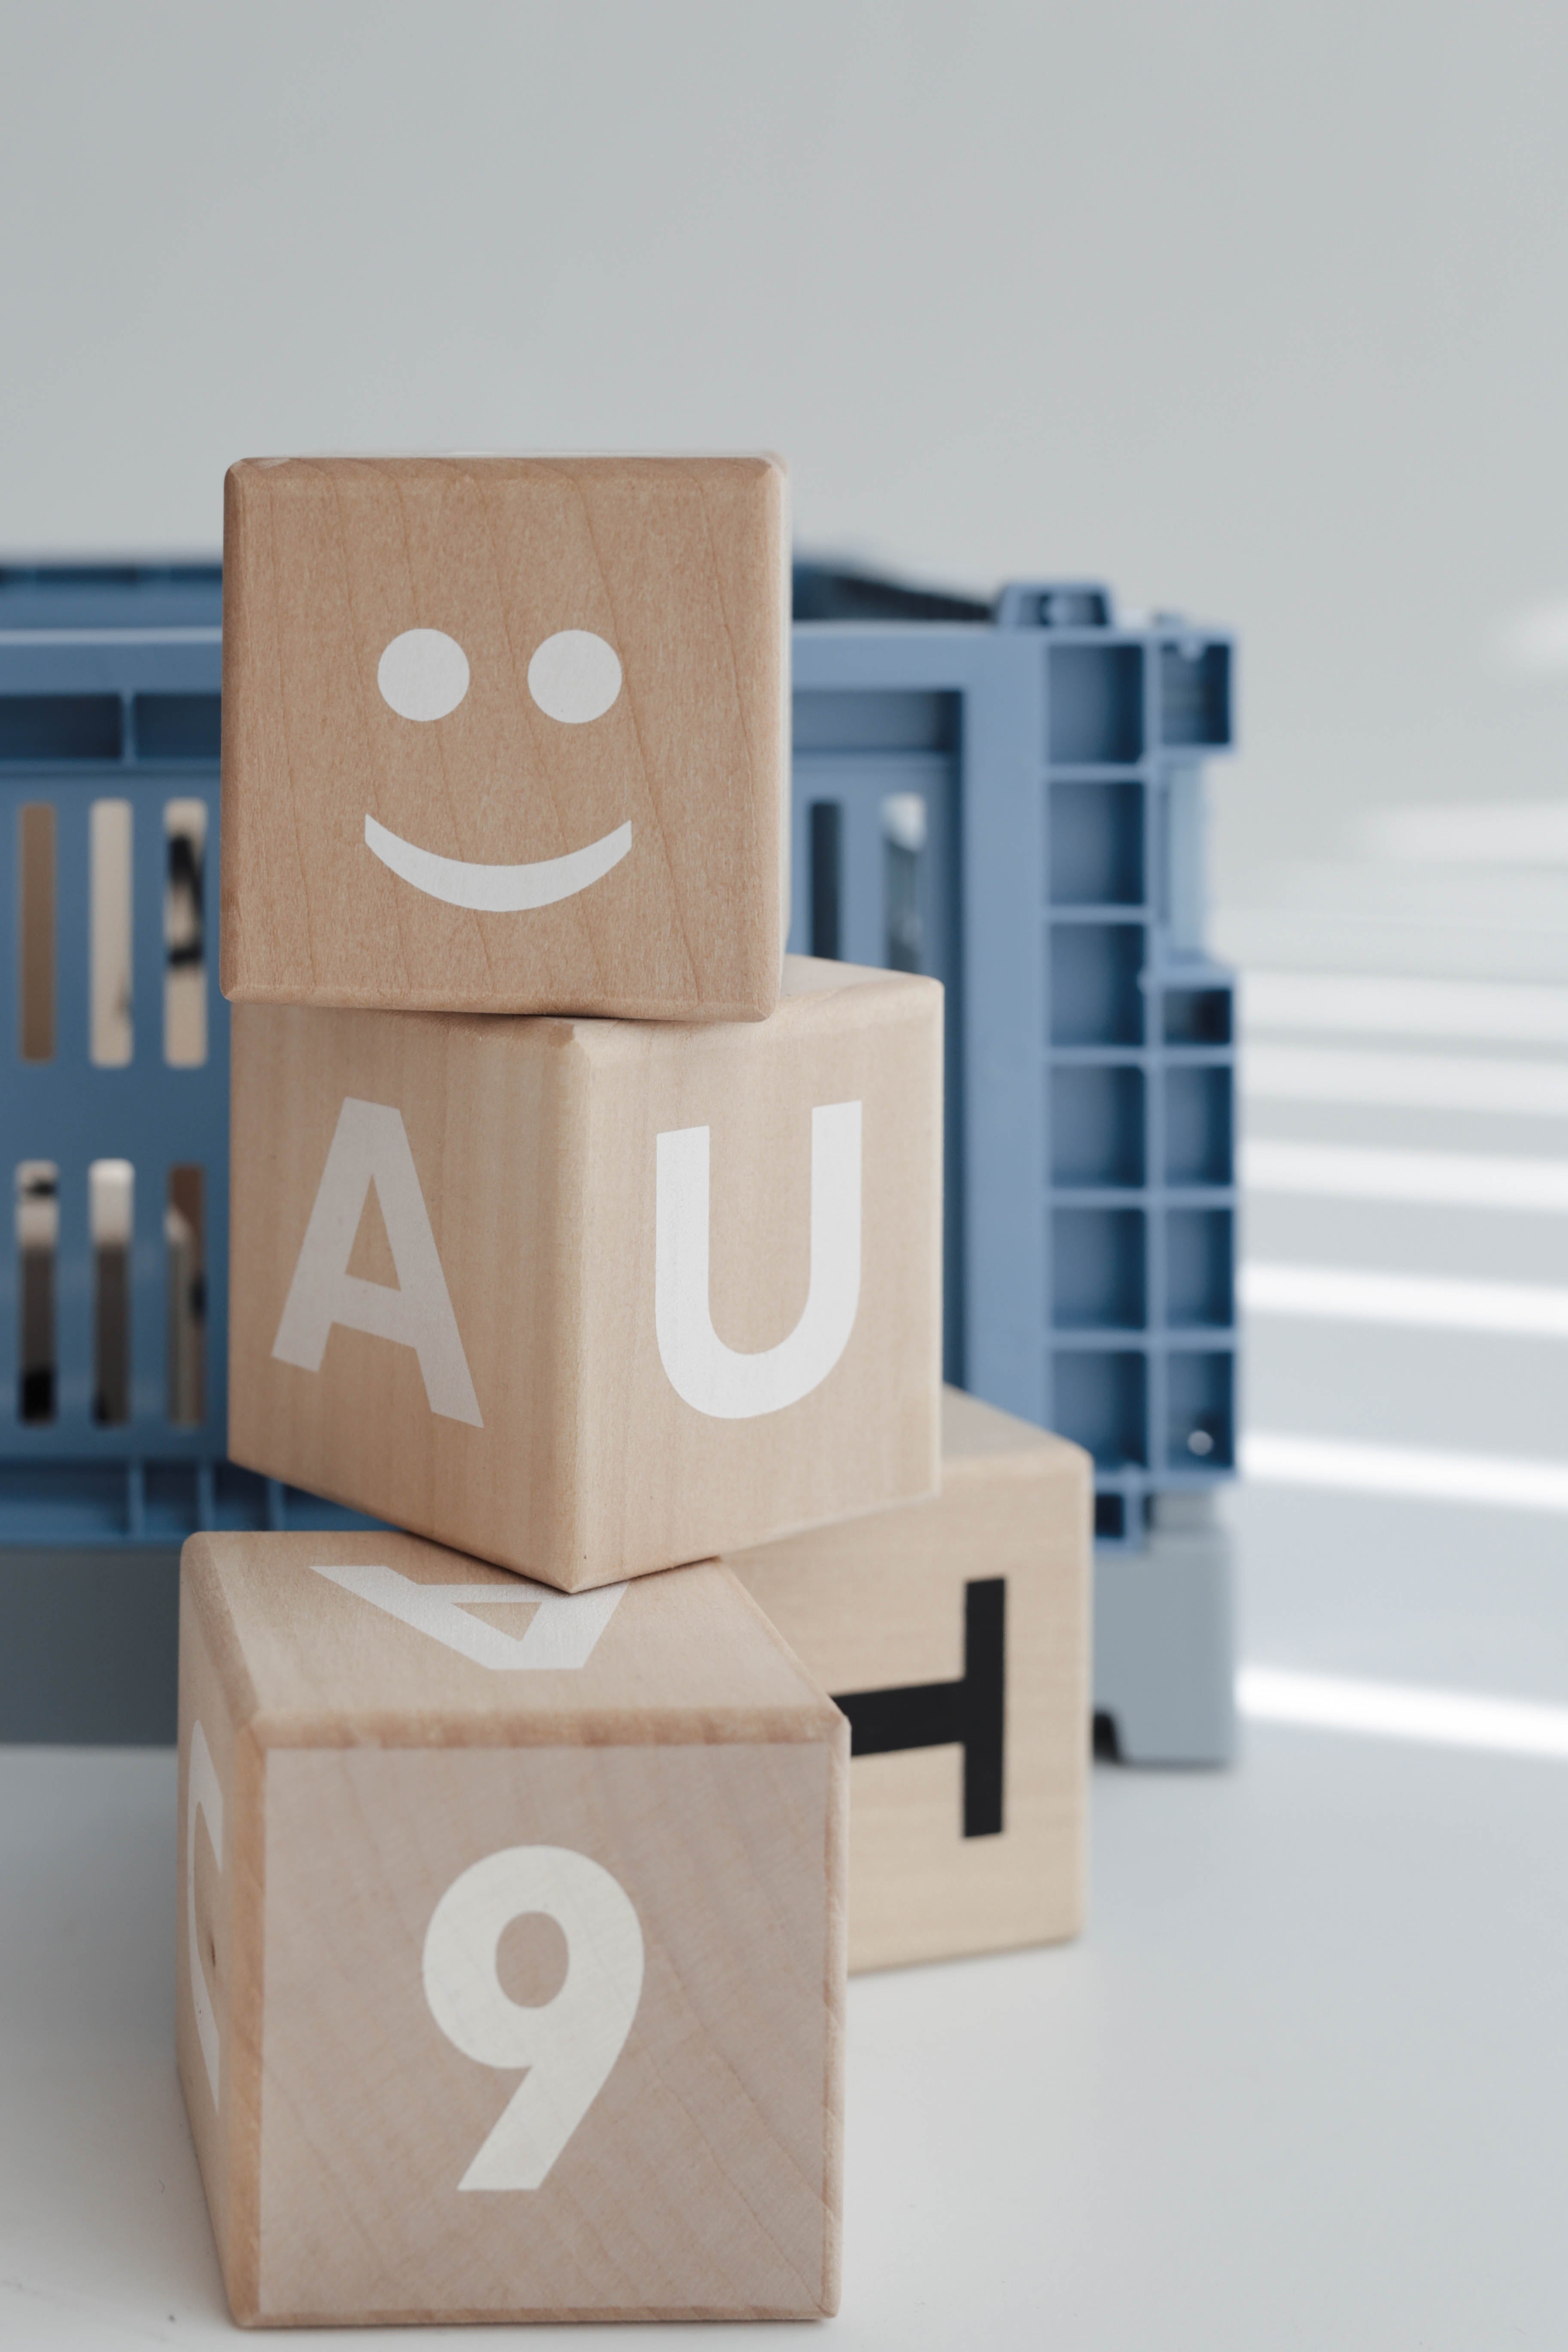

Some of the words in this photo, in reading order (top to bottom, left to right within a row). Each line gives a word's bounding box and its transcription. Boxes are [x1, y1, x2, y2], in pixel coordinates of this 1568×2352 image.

[271, 1096, 484, 1428] A
[654, 1099, 861, 1419] U
[309, 1565, 629, 1669] A
[422, 1844, 645, 2191] 9
